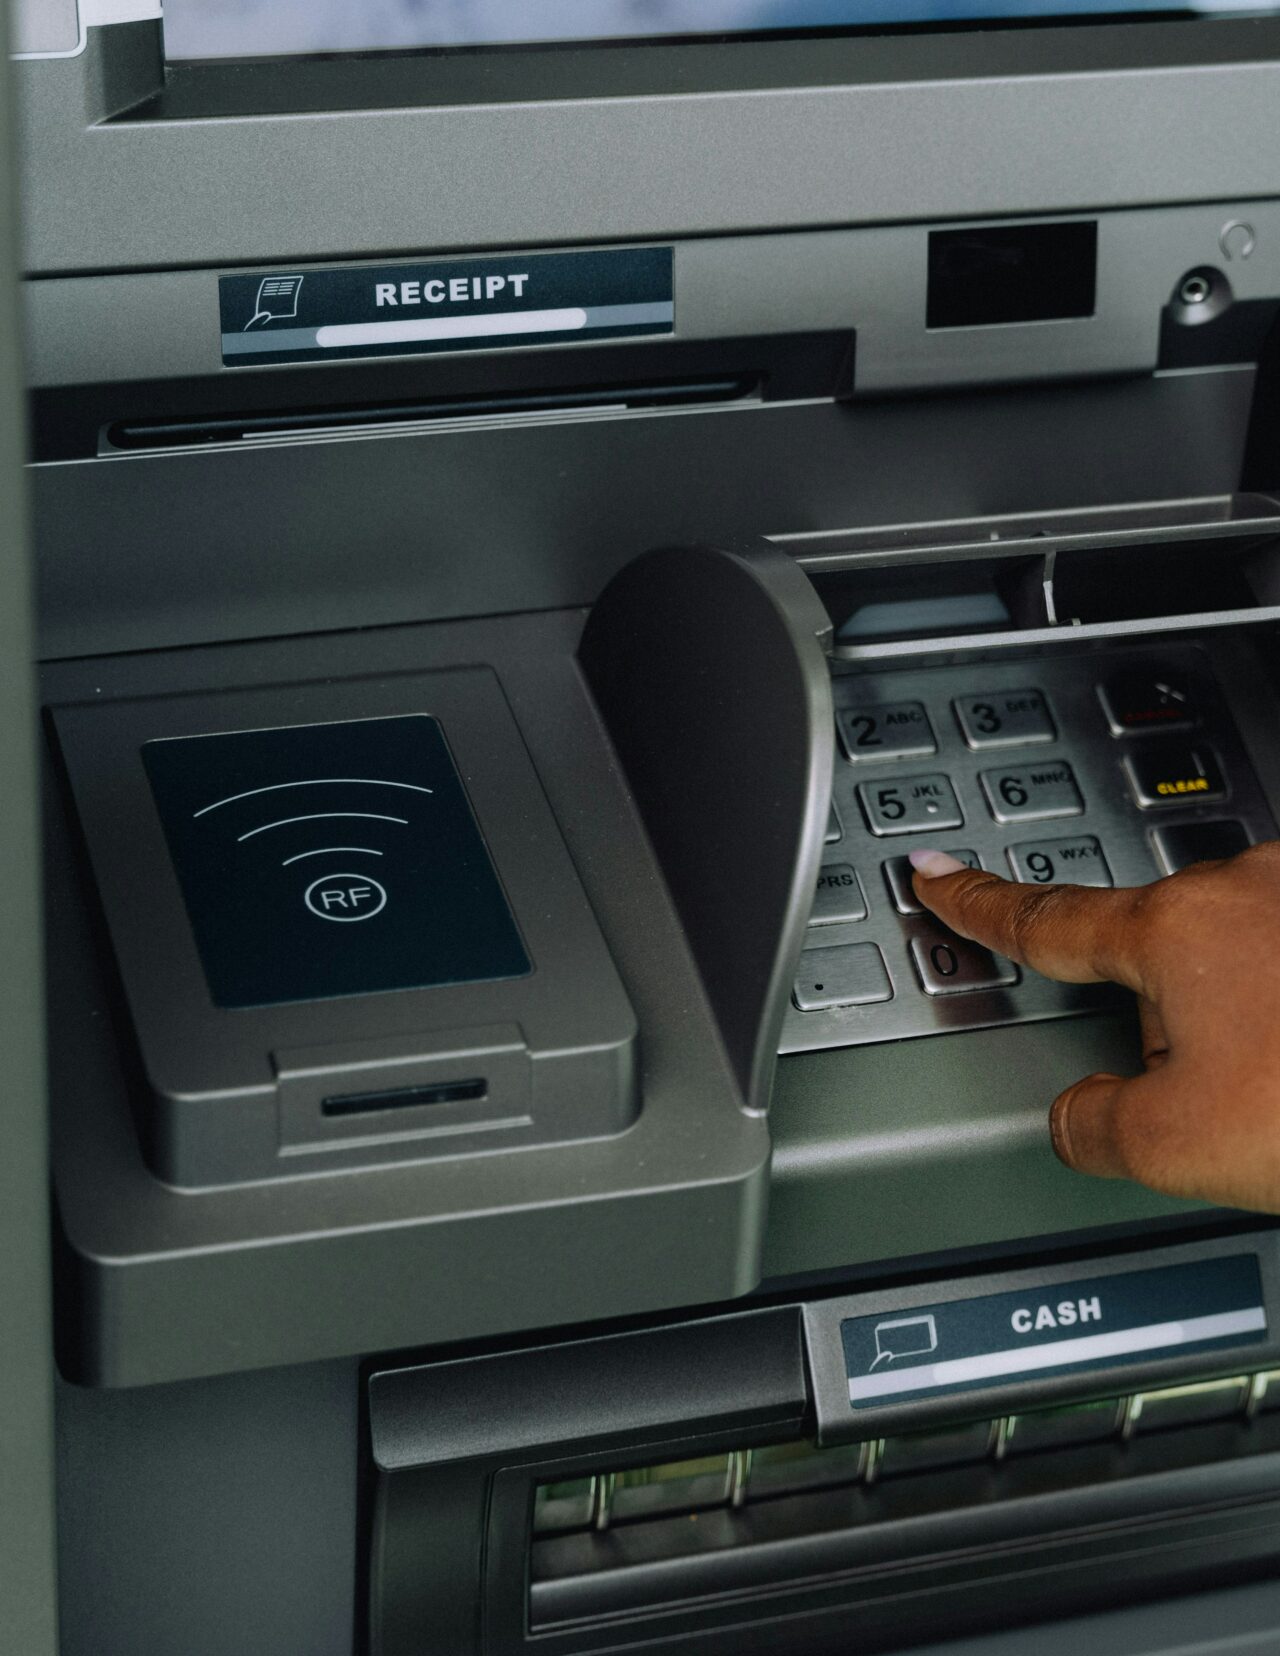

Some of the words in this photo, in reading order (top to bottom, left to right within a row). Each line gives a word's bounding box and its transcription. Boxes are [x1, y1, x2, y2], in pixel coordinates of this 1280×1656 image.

[375, 274, 529, 307] RECEIPT
[851, 716, 882, 747] 2
[886, 712, 923, 725] ABC
[972, 704, 1001, 733] 3
[1006, 698, 1040, 712] DEF
[877, 788, 906, 819] 5
[911, 783, 944, 798] JKL
[999, 776, 1028, 806] 6
[1156, 777, 1210, 795] CLEAR
[1026, 852, 1055, 883] 9
[321, 887, 371, 910] RF
[930, 944, 959, 977] 0
[1011, 1296, 1102, 1334] CASH
